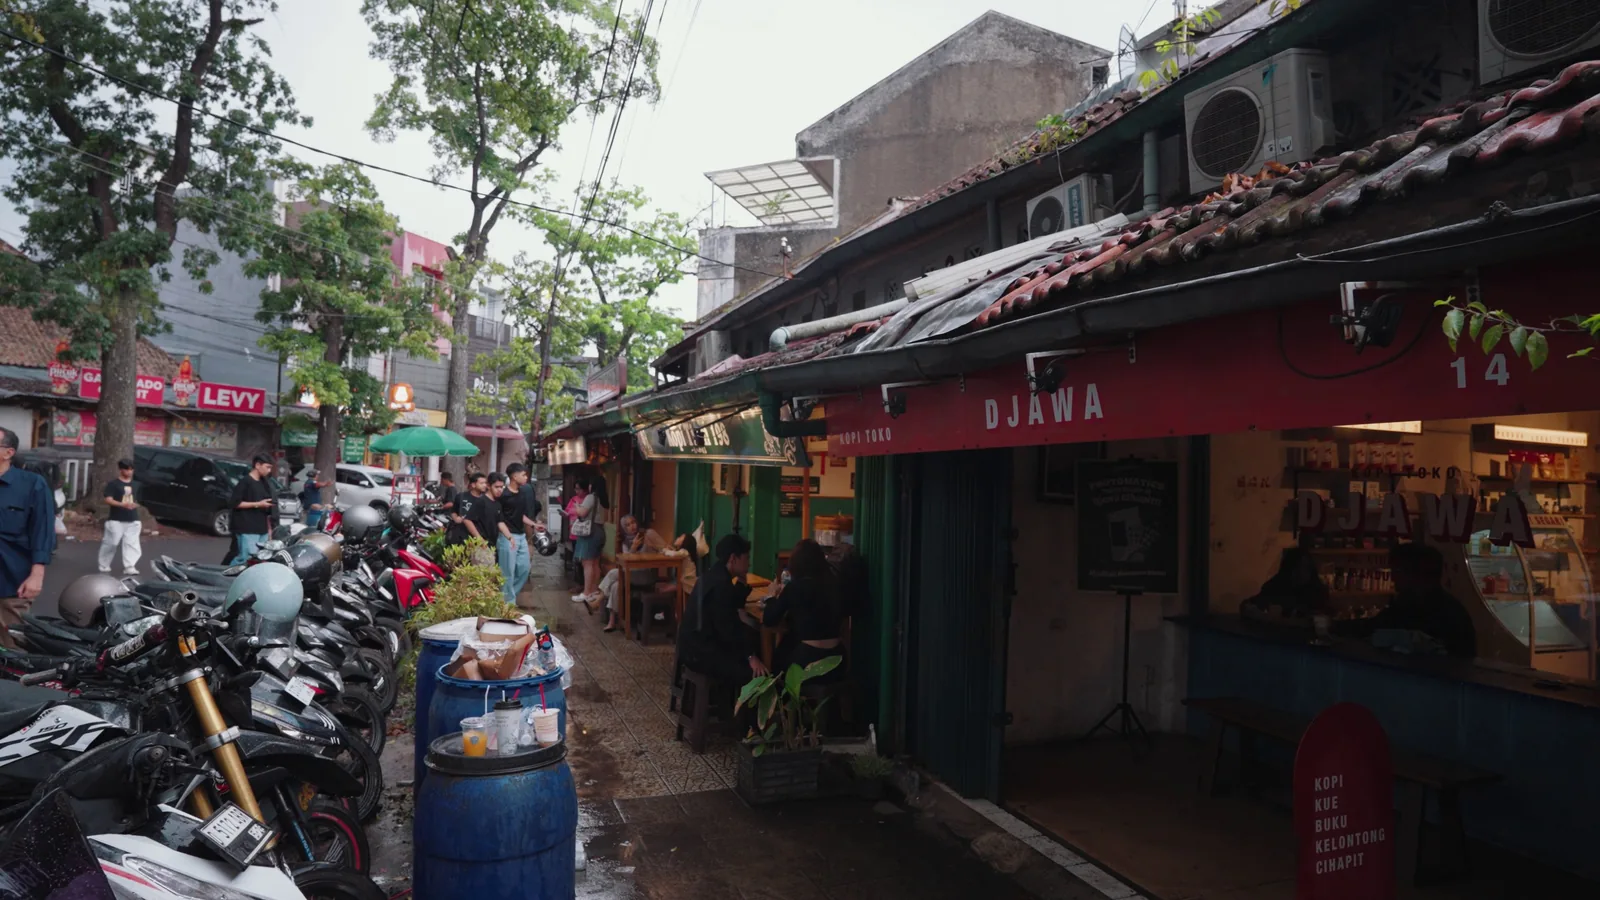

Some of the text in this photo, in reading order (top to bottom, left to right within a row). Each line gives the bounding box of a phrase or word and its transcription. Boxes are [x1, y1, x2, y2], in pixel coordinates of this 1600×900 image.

[136, 380, 163, 391] ADO
[203, 387, 260, 410] LEVY
[985, 383, 1104, 430] DJAWA
[839, 427, 892, 445] KOPI TOKO
[1298, 491, 1534, 547] DJAWA
[38, 722, 68, 735] 150
[1314, 774, 1344, 791] KOPI
[1315, 796, 1338, 812] KUE
[1315, 815, 1348, 833] BUKU
[1315, 828, 1386, 853] KELONTONG
[1316, 852, 1364, 875] CIHAPIT
